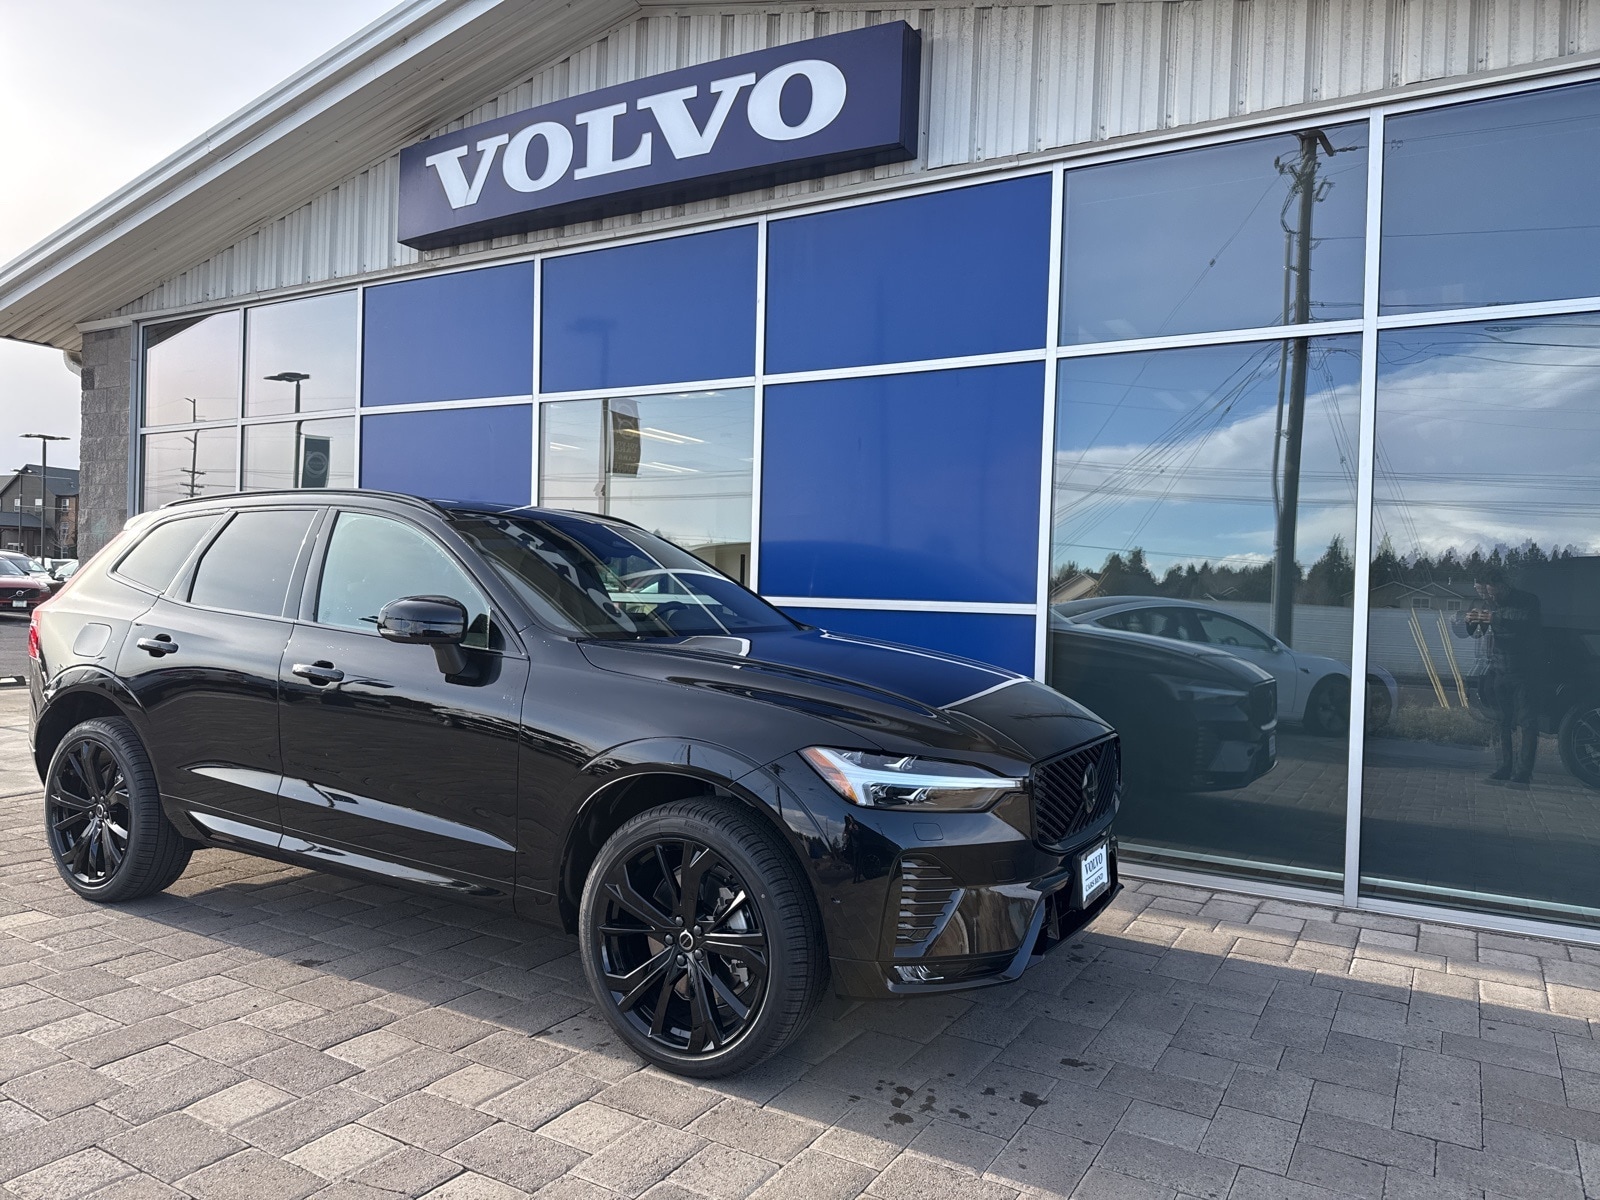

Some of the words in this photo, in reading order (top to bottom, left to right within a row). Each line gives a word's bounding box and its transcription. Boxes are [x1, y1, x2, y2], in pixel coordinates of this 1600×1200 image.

[426, 59, 847, 210] VOLVO
[1085, 852, 1103, 874] VOLVO
[1085, 880, 1095, 891] CARS
